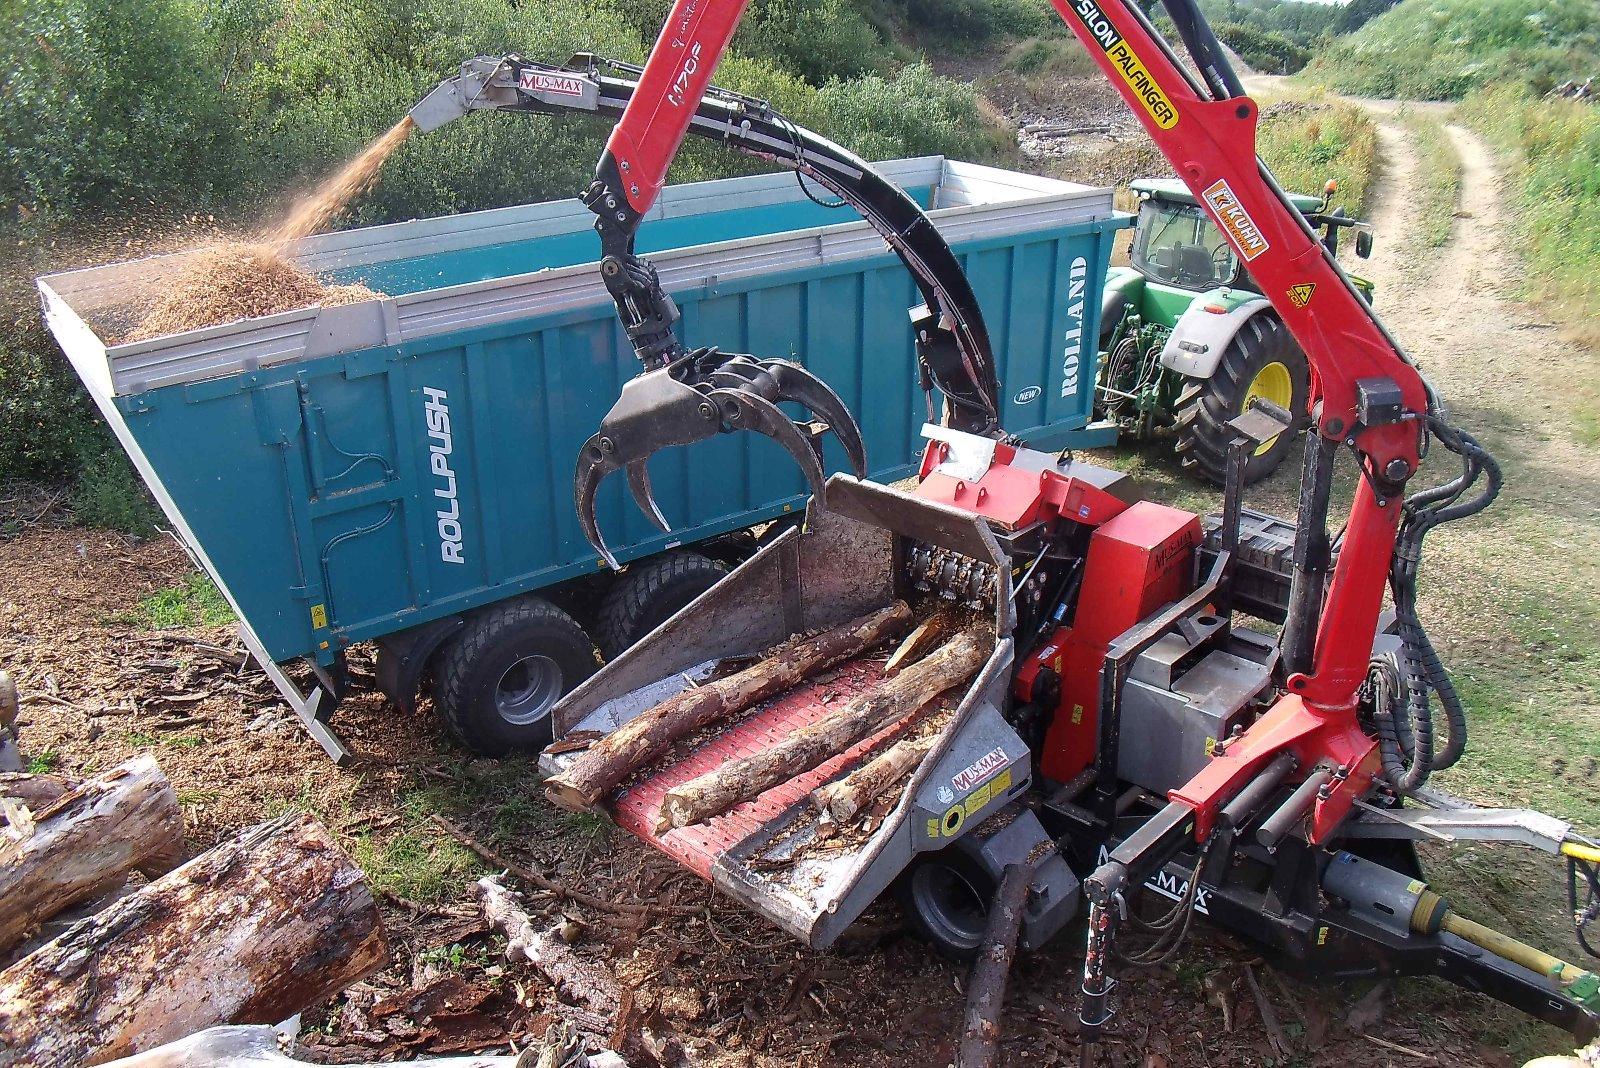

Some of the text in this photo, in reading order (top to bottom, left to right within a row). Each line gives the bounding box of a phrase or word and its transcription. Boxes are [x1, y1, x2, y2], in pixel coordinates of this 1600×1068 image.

[520, 74, 581, 92] MUS-MAX
[1076, 0, 1174, 124] SILON PALFINGER
[1226, 206, 1263, 249] KUHN
[1061, 256, 1087, 398] ROLLAND
[1018, 388, 1038, 402] NEW
[423, 386, 465, 564] ROLLPUSH
[953, 748, 1005, 791] MUS-MAX
